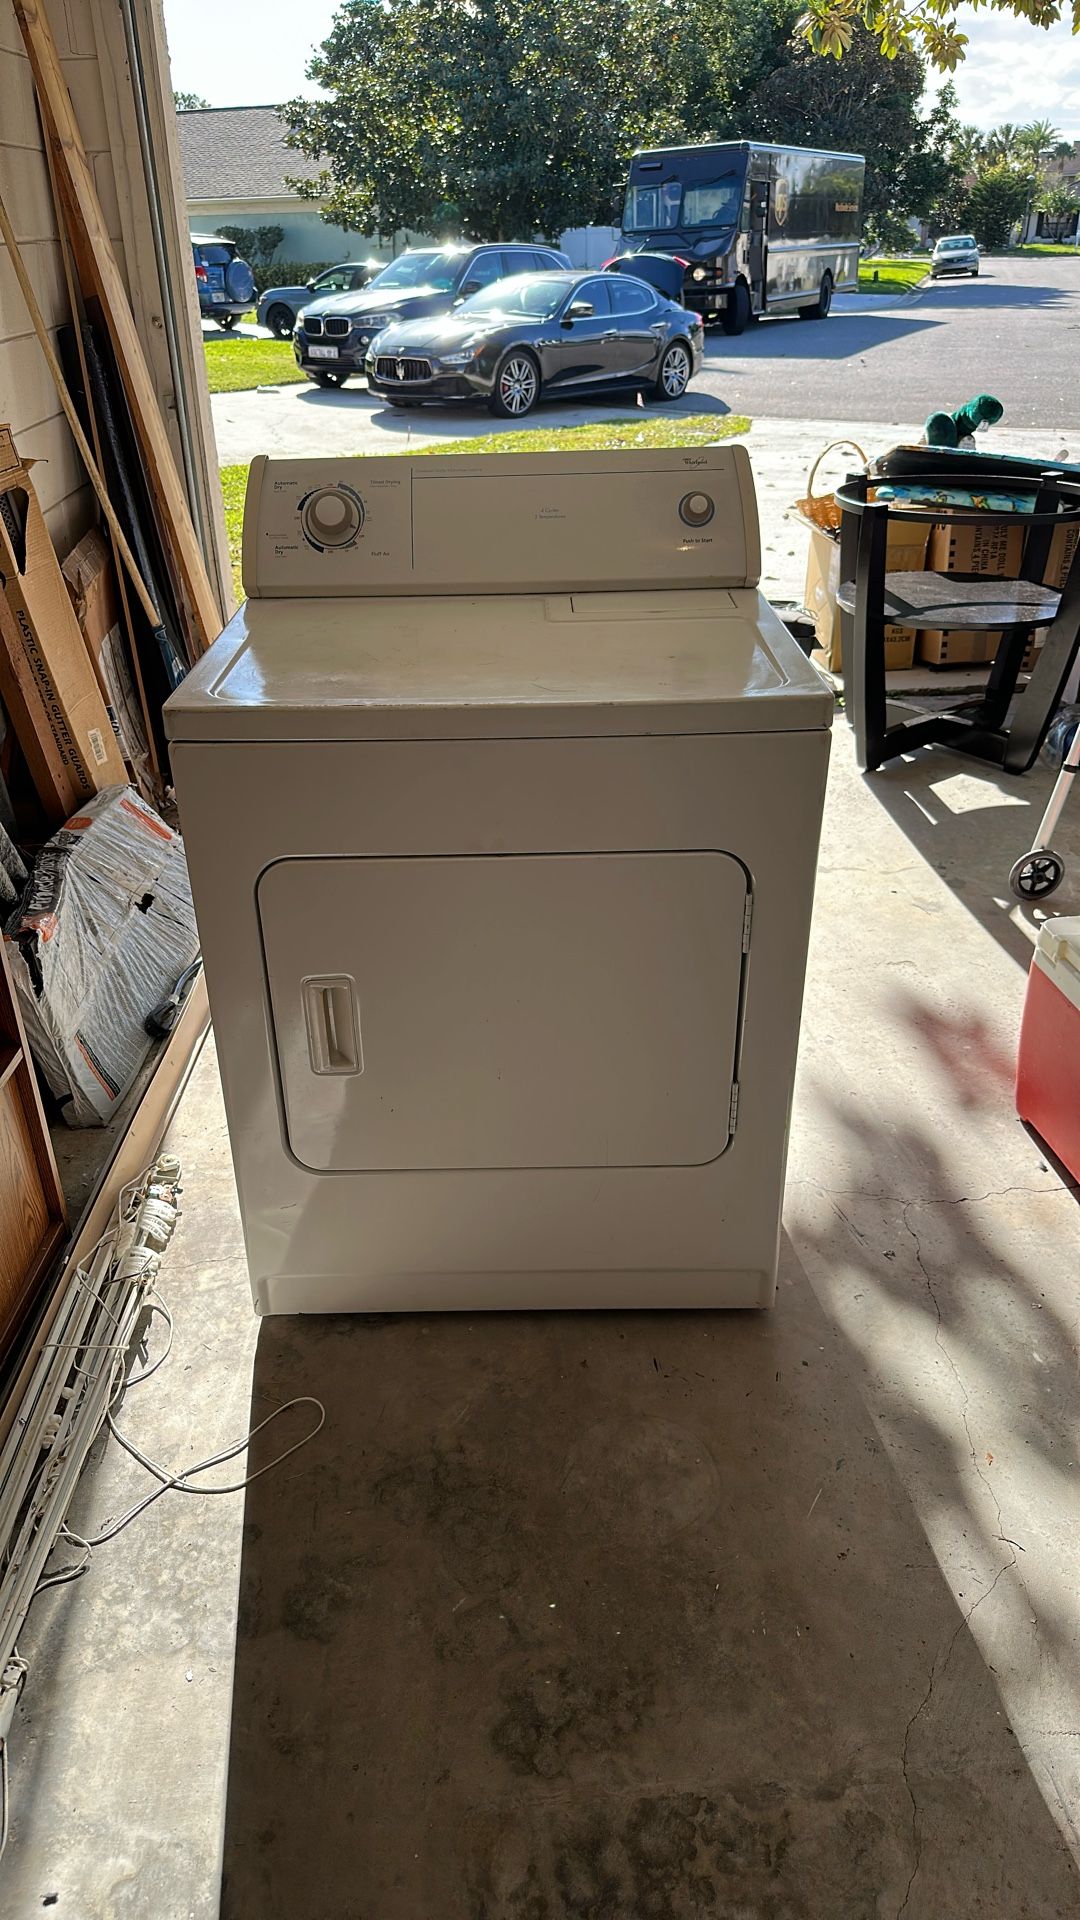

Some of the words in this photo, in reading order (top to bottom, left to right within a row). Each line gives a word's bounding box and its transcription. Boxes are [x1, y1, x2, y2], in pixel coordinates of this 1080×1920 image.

[973, 527, 983, 553] NTAINS
[1063, 529, 1075, 564] CONTAINS
[981, 548, 989, 571] CHINA
[996, 553, 1006, 571] DOLL
[16, 609, 38, 655] PLASTIC
[33, 658, 57, 701] SNAP-IN
[51, 704, 72, 745] GUTTER
[68, 748, 91, 791] GUARDS
